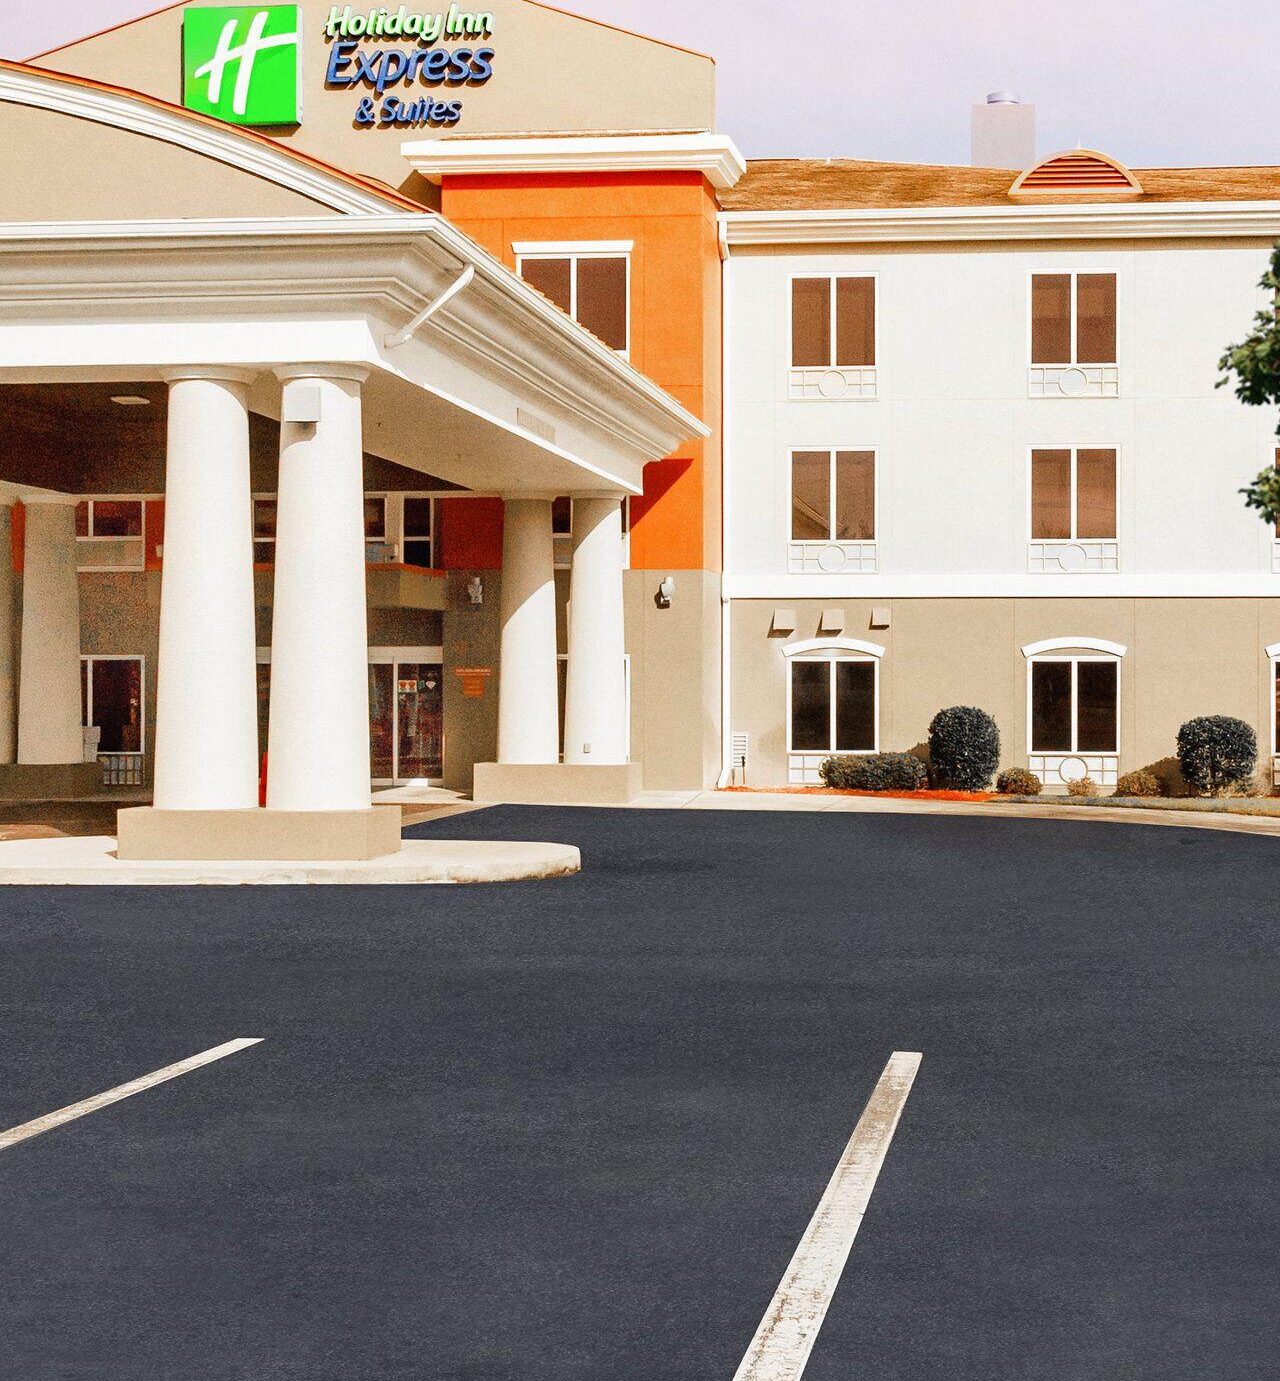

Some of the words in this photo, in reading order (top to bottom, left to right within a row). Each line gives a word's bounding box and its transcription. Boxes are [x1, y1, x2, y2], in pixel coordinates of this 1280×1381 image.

[324, 4, 443, 41] Holiday
[445, 2, 495, 35] Inn
[326, 41, 495, 93] Express
[355, 96, 375, 123] &
[381, 95, 463, 123] Suites
